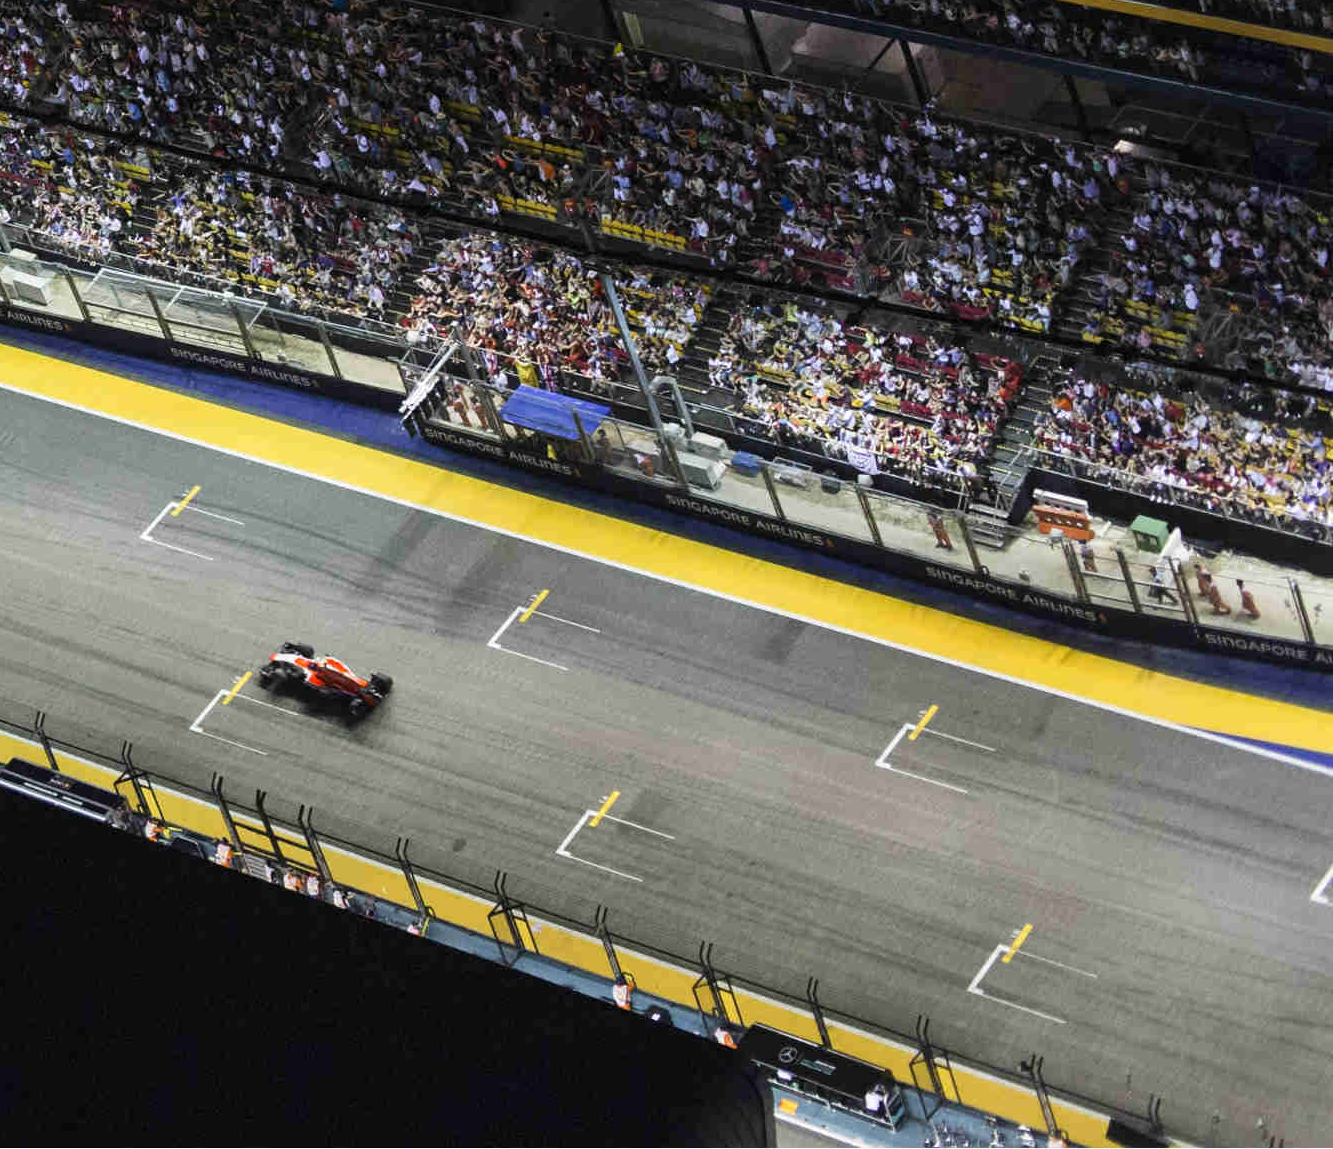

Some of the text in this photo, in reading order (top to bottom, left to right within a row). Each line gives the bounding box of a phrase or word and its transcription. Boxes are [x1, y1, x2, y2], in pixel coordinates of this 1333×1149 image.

[509, 451, 573, 476] AIRLINES
[756, 519, 825, 547] AIRLINES
[925, 565, 1097, 622] SINGAPORE AIRLINES
[1205, 633, 1309, 660] SINGAPORE
